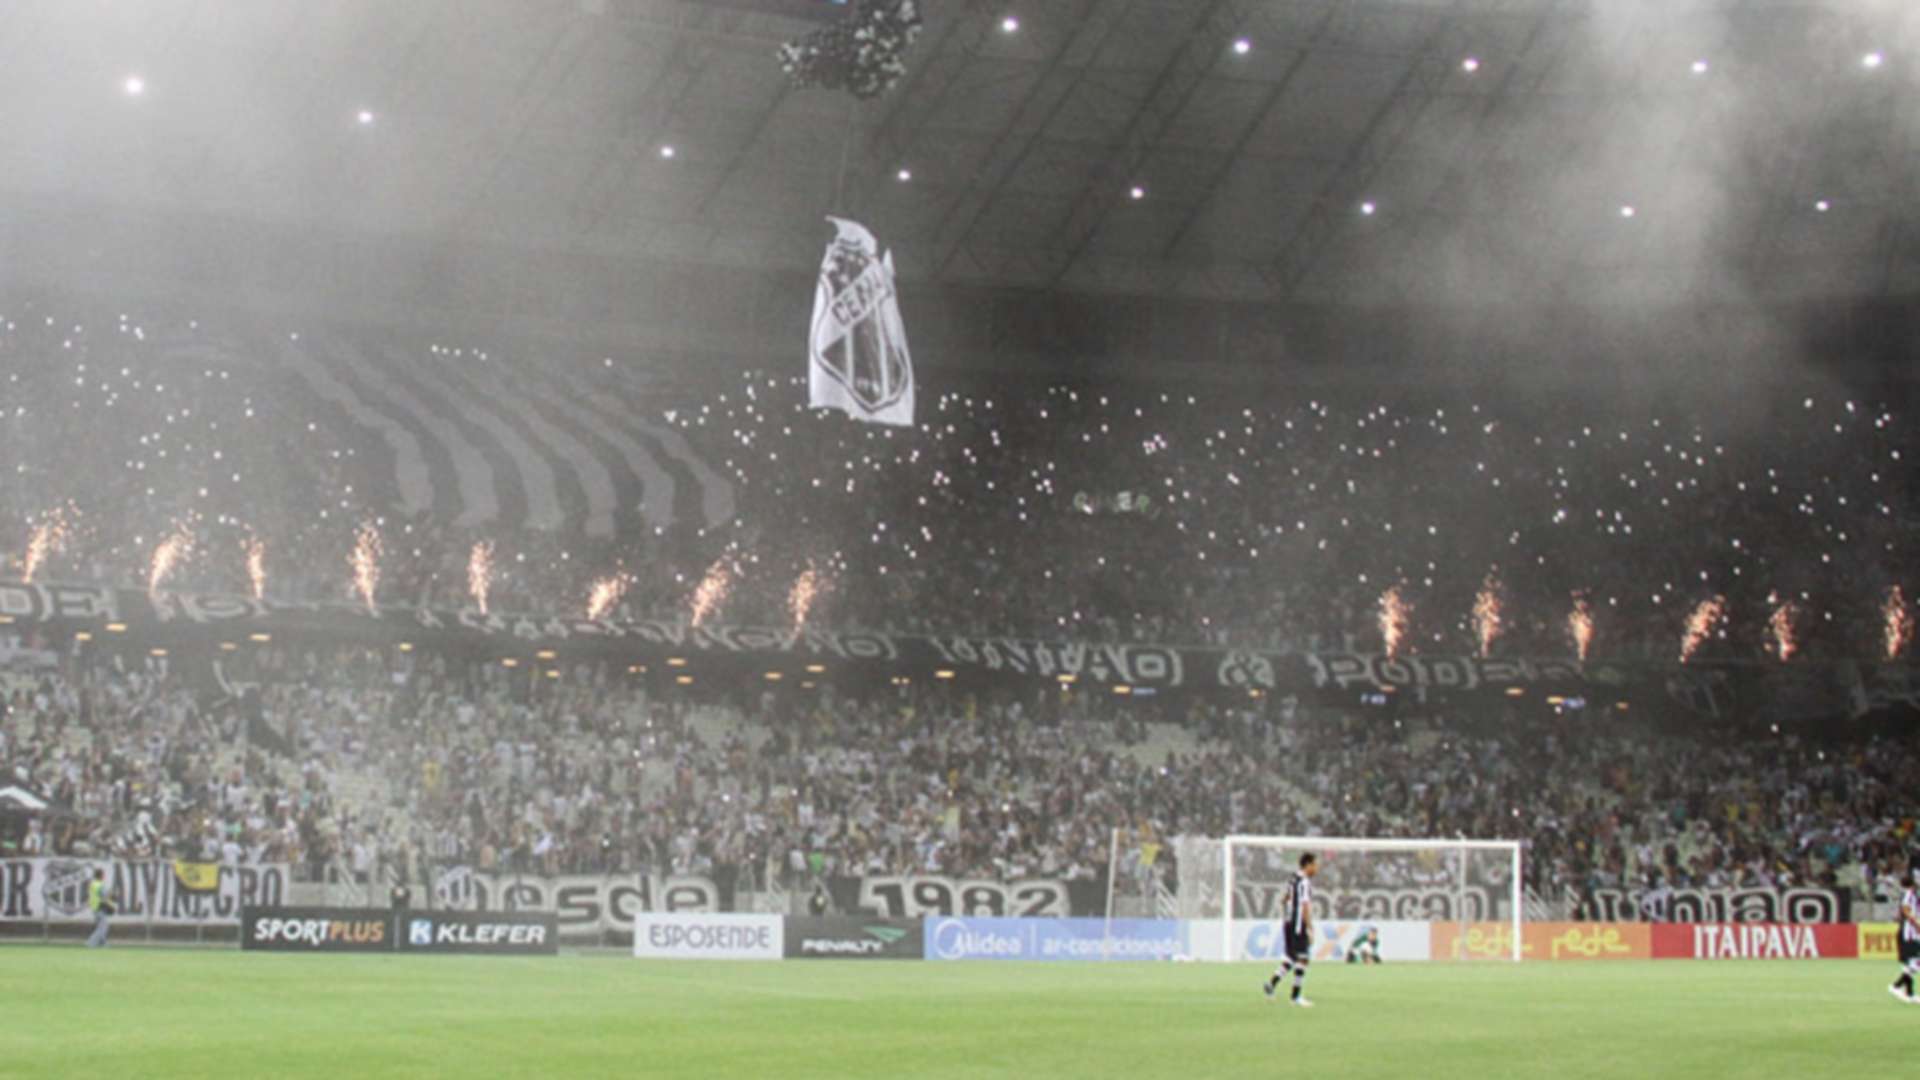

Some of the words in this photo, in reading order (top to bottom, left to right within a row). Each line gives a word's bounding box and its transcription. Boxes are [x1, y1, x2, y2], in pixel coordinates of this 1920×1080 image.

[864, 880, 1064, 918] 1982
[254, 918, 385, 946] SPORTPLUS
[437, 921, 546, 944] KLEFER
[650, 923, 769, 949] ESPOSENDE
[803, 938, 883, 953] PENALTY
[1452, 924, 1533, 959] rede
[1552, 924, 1632, 958] rede
[1693, 926, 1820, 957] ITAIPAVA
